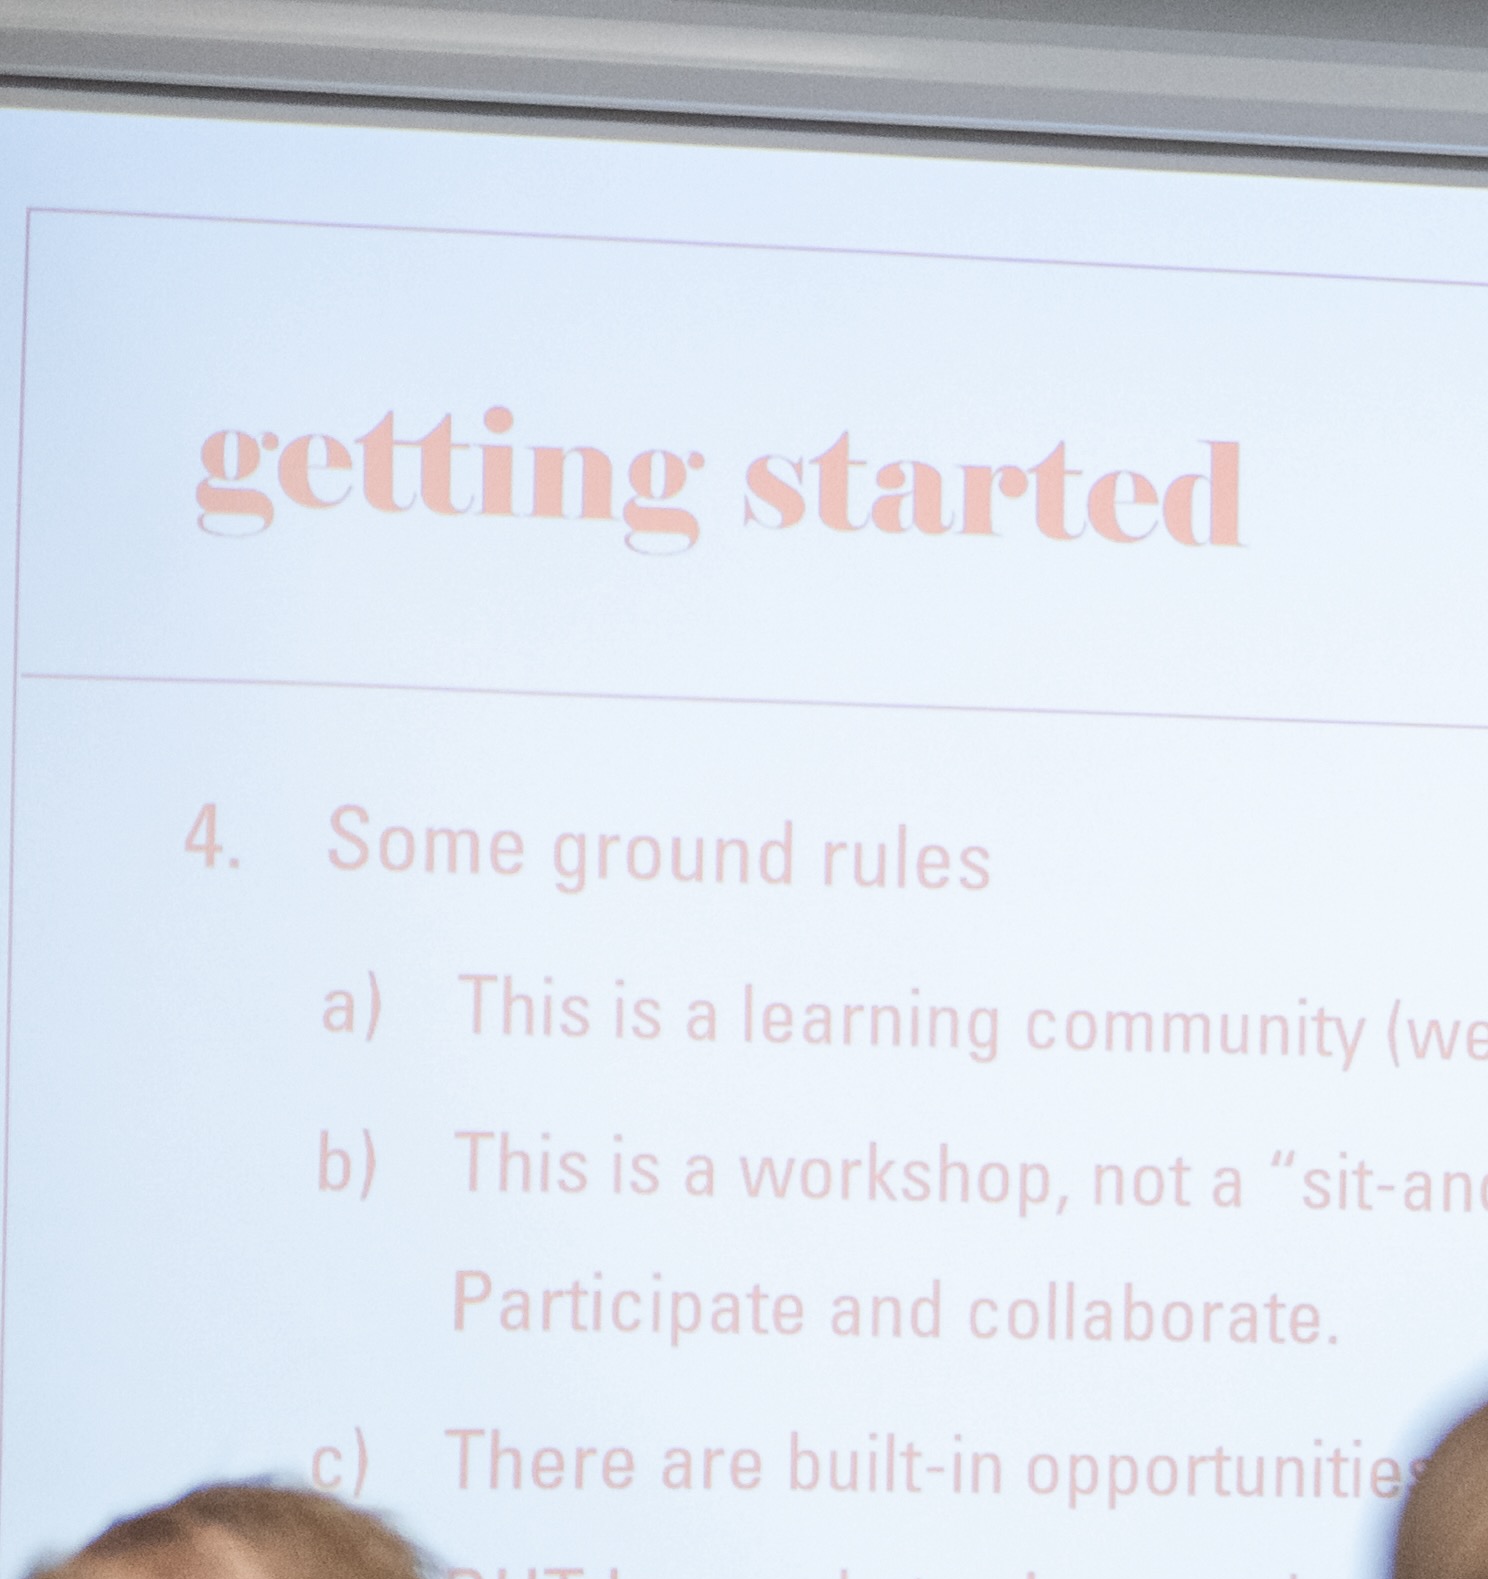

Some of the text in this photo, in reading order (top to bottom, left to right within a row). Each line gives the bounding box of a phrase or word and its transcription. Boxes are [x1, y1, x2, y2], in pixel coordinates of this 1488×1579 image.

[195, 406, 1247, 558] getting started
[184, 802, 994, 895] 4. Some ground rules
[322, 971, 383, 1042] a)
[459, 972, 591, 1039] This
[614, 979, 663, 1042] is
[687, 1000, 718, 1042] a
[743, 984, 1000, 1065] learning
[1026, 998, 1366, 1072] community
[317, 1129, 377, 1201] b)
[455, 1129, 589, 1194] This
[612, 1133, 661, 1197] is
[685, 1155, 716, 1197] a
[739, 1142, 1069, 1218] workshop,
[1093, 1158, 1189, 1208] not
[1212, 1167, 1243, 1209] a
[453, 1268, 1337, 1346] Participate and collaborate.
[311, 1425, 369, 1499] c)
[445, 1427, 636, 1491] There
[662, 1447, 763, 1491] are
[789, 1431, 1003, 1494] built-in
